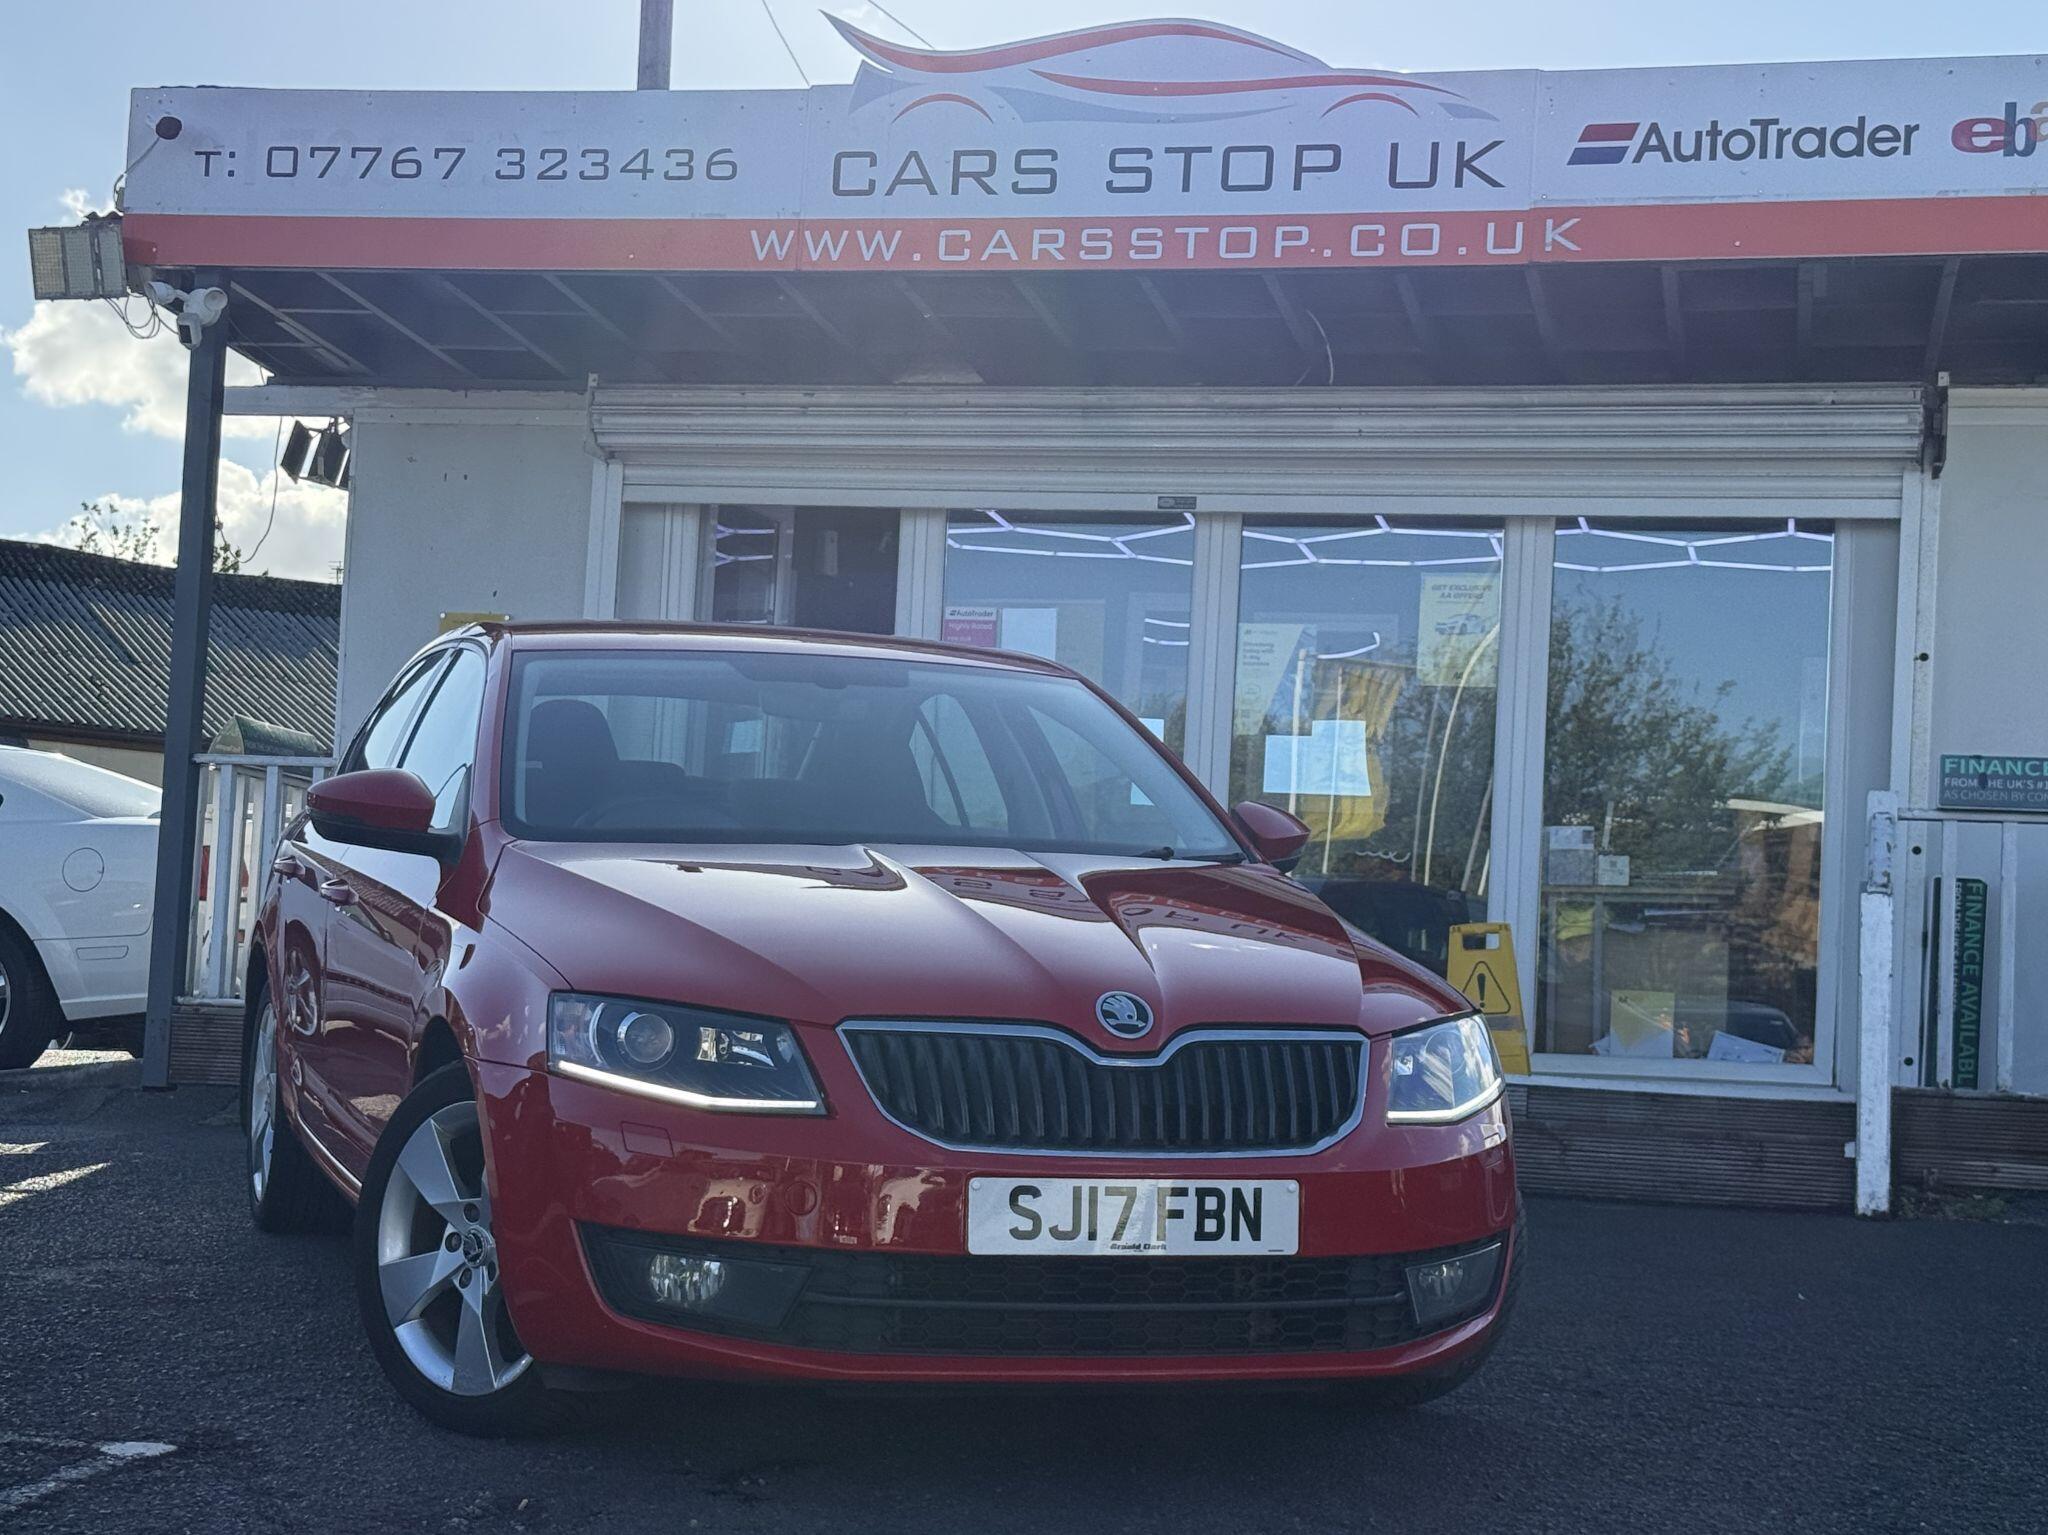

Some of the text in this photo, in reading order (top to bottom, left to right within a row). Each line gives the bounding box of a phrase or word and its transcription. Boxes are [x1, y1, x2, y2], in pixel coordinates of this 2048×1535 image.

[1632, 115, 1919, 164] AutoTrader
[194, 146, 739, 182] T: 07767 323436
[831, 140, 1506, 197] CARS STOP UK
[956, 609, 994, 617] AutoTrader
[1944, 777, 1977, 788] FROM
[1983, 778, 2004, 789] HE
[2006, 779, 2034, 790] UK'S
[1944, 789, 1959, 800] AS
[1960, 789, 2008, 801] CHOSEN
[2011, 790, 2025, 801] BY
[1958, 882, 1984, 1084] FINANCE AVAILABL
[1008, 1184, 1263, 1242] SJ17 FBN
